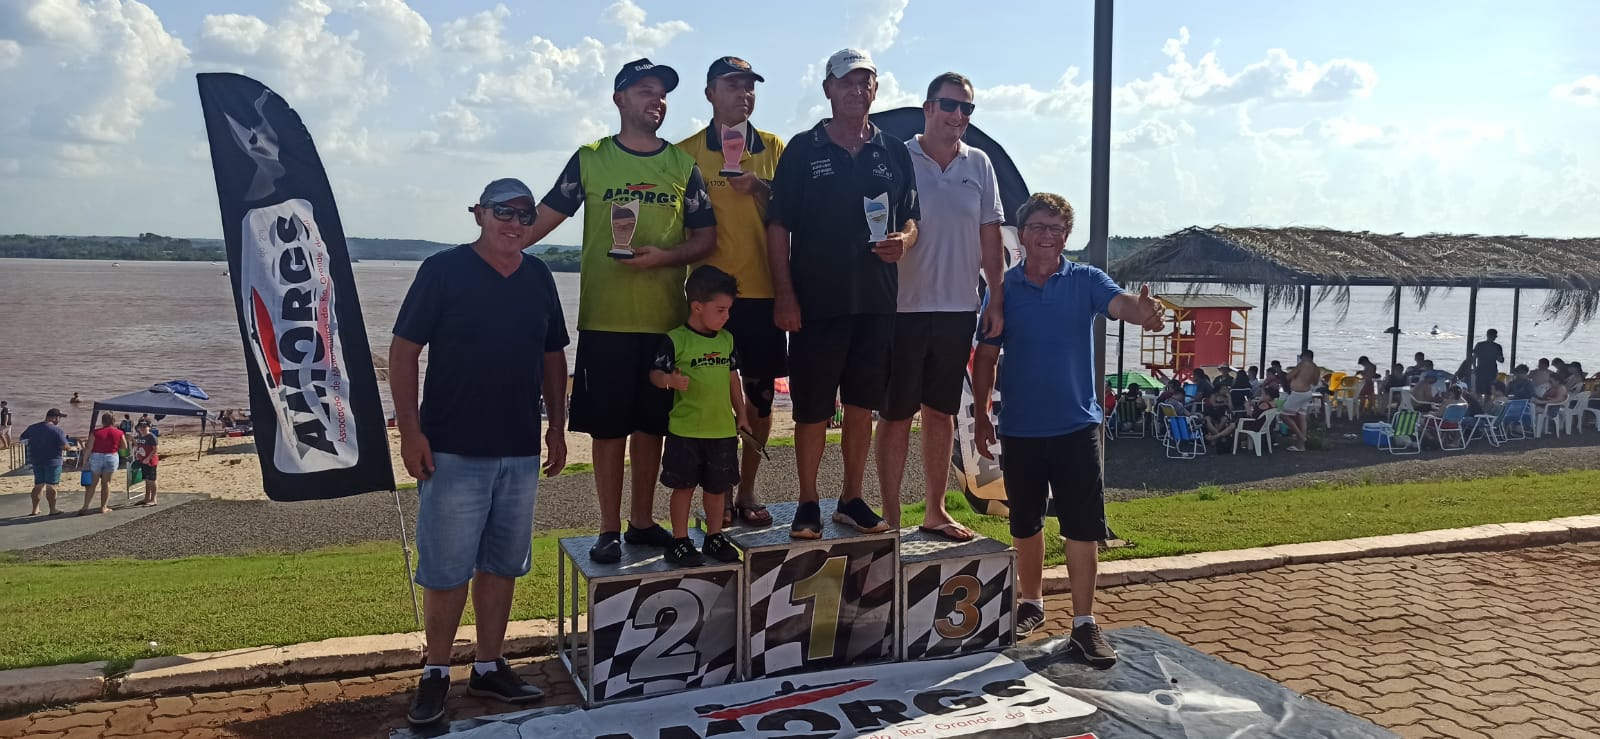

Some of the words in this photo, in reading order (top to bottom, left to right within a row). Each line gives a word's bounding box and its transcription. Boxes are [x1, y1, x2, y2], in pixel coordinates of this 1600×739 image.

[602, 188, 679, 207] AMORGS
[316, 251, 328, 284] Grande
[1012, 248, 1023, 260] Sul
[317, 289, 328, 301] Rio
[319, 305, 329, 318] do
[275, 212, 340, 456] AMORGS
[1203, 321, 1224, 336] 72
[330, 379, 341, 390] de
[333, 395, 348, 443] Associação
[791, 555, 848, 661] 1
[934, 574, 982, 639] 3
[628, 588, 703, 681] 2
[594, 679, 1051, 739] ORGS
[898, 728, 927, 737] Rio
[935, 716, 997, 731] Grande
[1005, 712, 1025, 720] do
[1031, 706, 1057, 716] Sul
